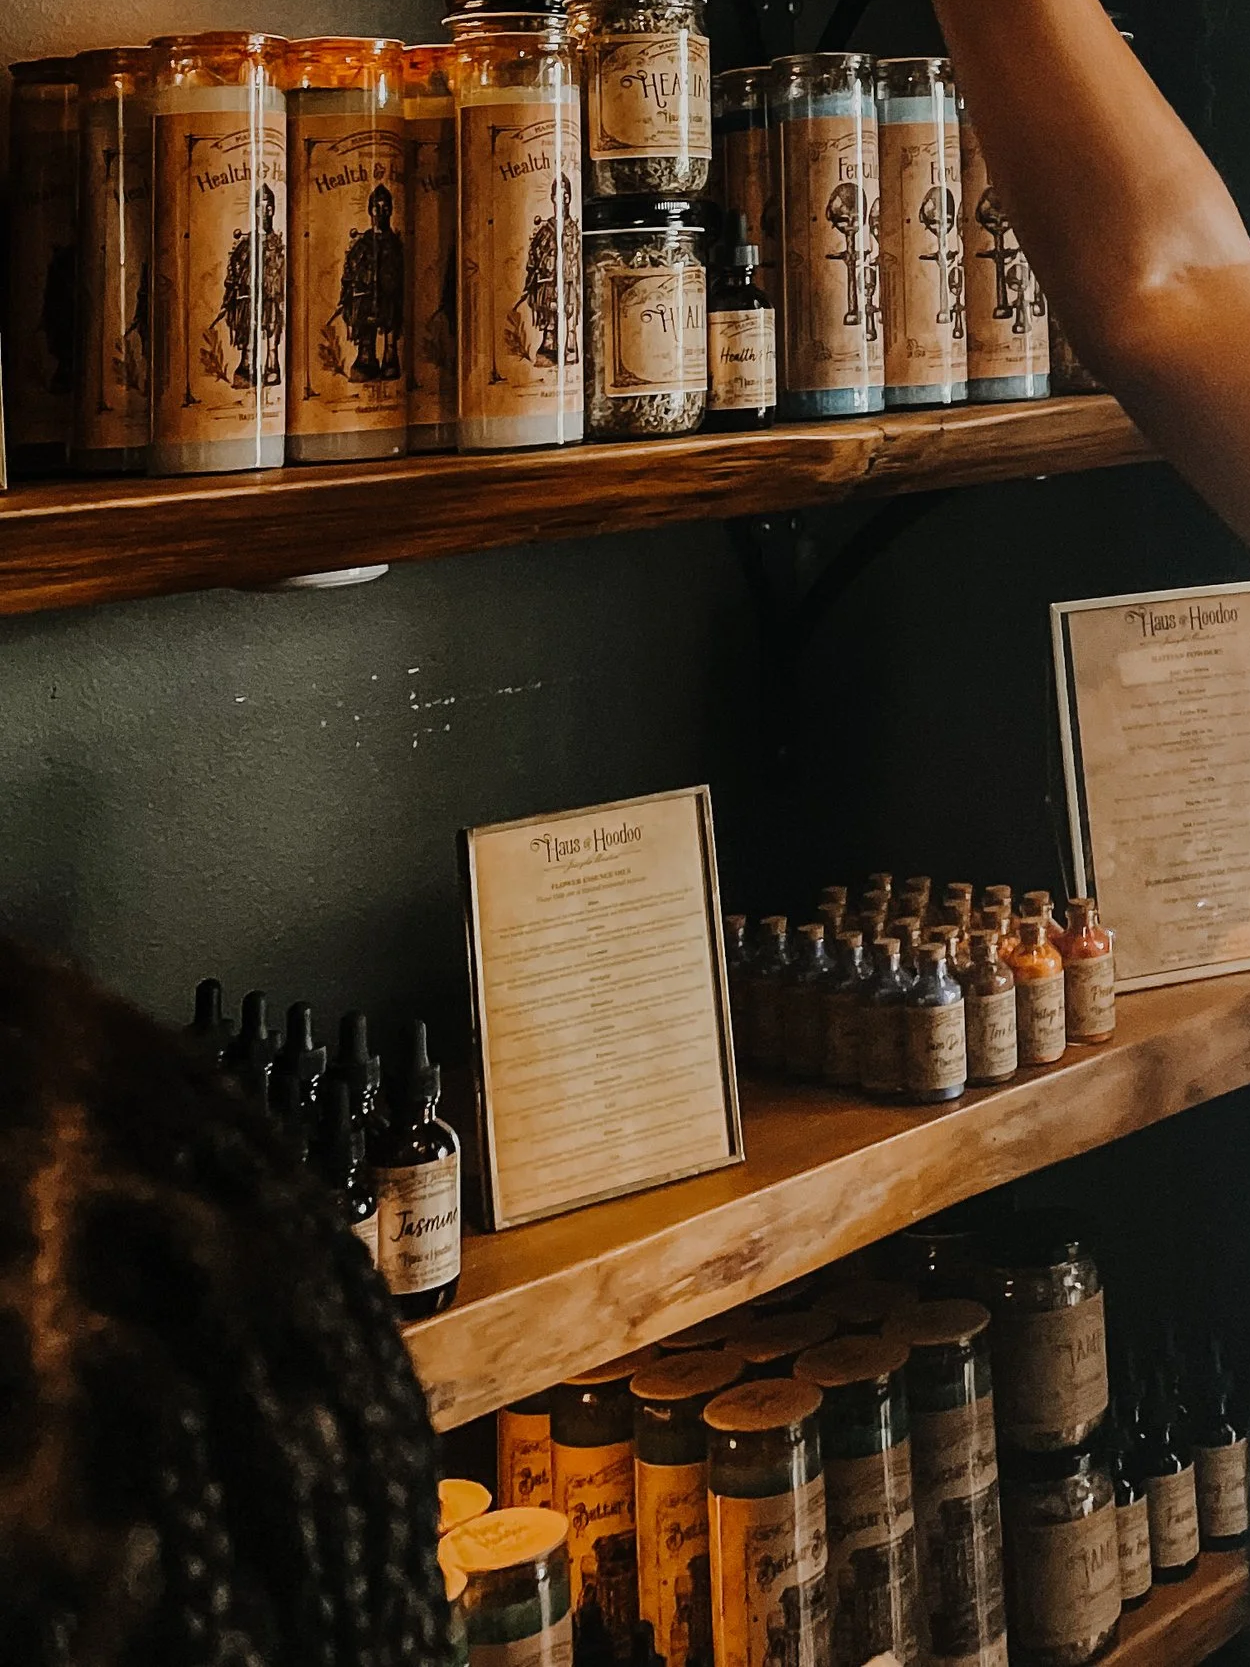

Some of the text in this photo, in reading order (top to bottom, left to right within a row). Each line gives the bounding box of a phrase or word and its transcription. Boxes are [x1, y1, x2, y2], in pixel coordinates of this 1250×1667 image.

[619, 69, 710, 108] HEAIN
[195, 161, 251, 193] Health
[315, 163, 369, 194] Health
[373, 161, 386, 181] &
[498, 151, 552, 182] Health
[720, 346, 757, 364] Health
[1124, 607, 1177, 637] Haus
[1189, 602, 1239, 631] Hoodoo
[530, 833, 581, 863] Haus
[593, 822, 642, 853] Hoodoo
